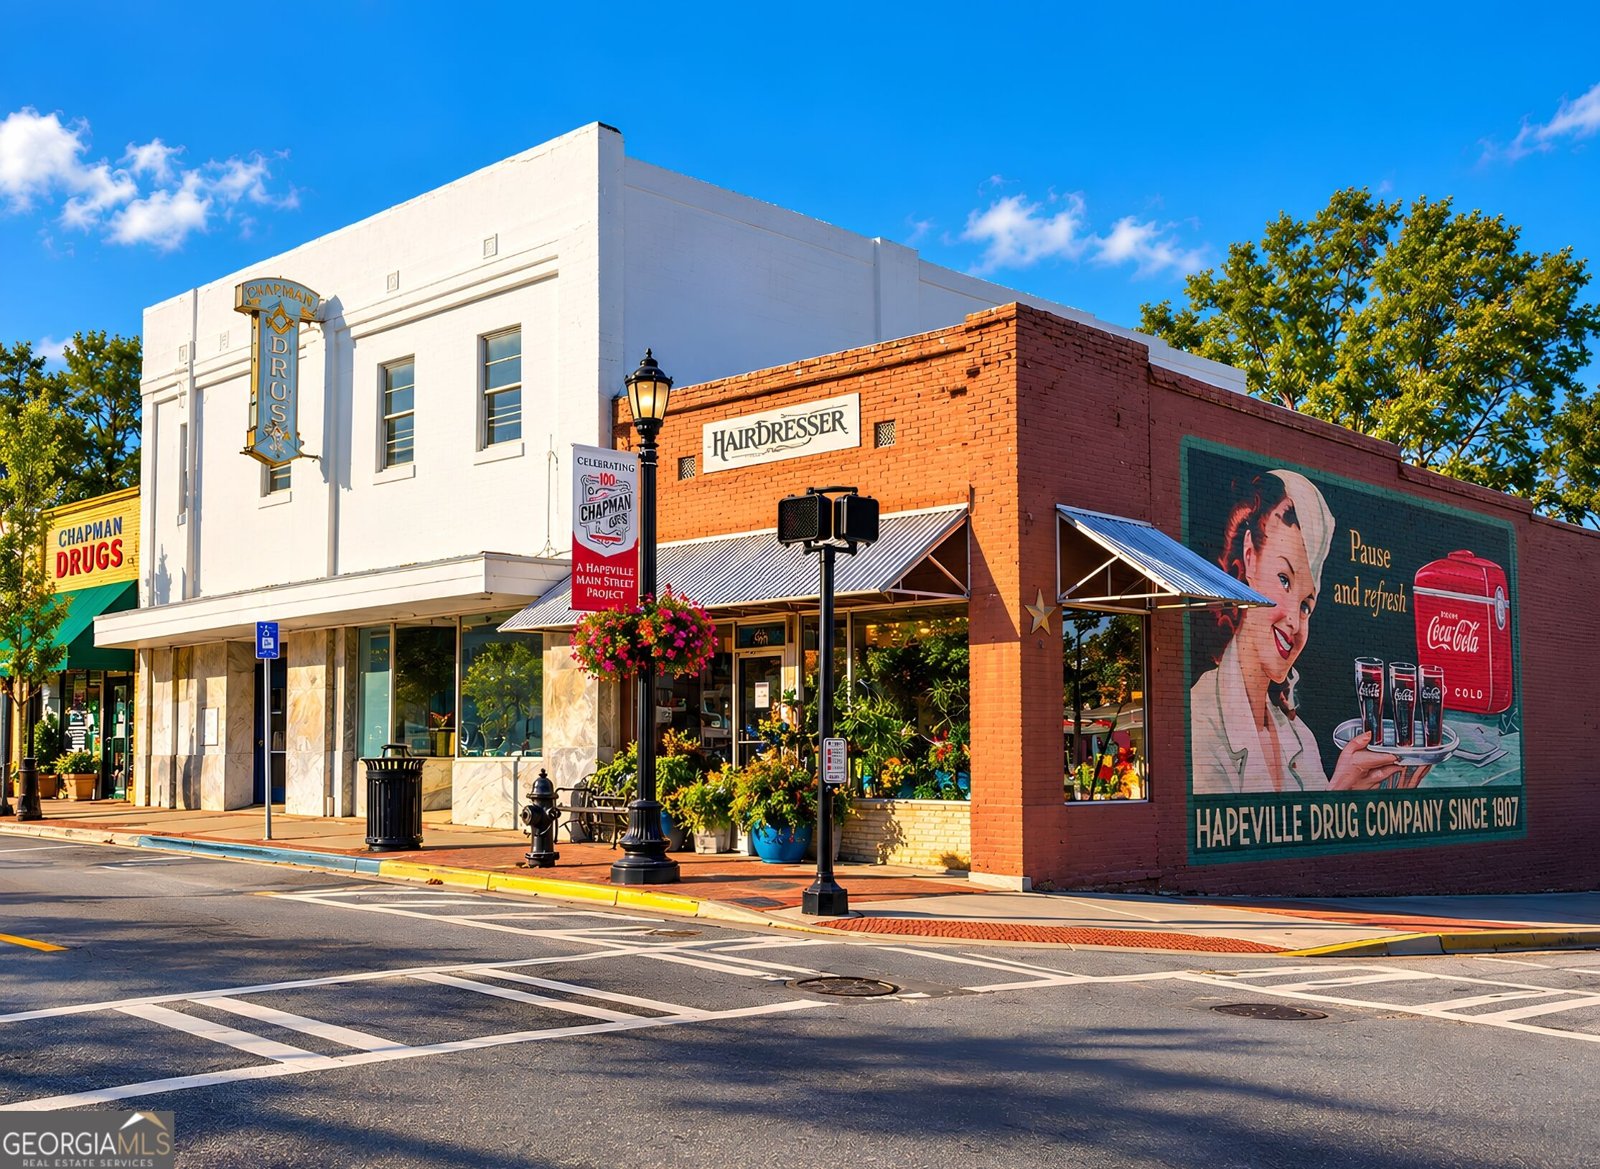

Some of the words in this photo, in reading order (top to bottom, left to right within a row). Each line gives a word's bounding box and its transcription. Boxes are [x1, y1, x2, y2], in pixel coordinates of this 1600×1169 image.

[711, 410, 849, 462] HAIRDRESSER
[577, 456, 635, 473] CELEBRATING
[599, 472, 616, 487] 100
[580, 494, 631, 522] CHAPMAN
[58, 516, 123, 548] CHAPMAN
[56, 538, 123, 579] DRUGS
[1350, 529, 1391, 568] Pause
[576, 562, 583, 572] A
[586, 563, 634, 576] HAPEVILLE
[576, 575, 601, 585] MAIN
[586, 587, 625, 600] PROJECT
[1334, 576, 1360, 606] and
[1364, 579, 1407, 617] refresh
[1454, 688, 1483, 699] COLD
[1196, 804, 1302, 849] HAPEVILLE
[1310, 802, 1358, 841] DRUG
[1365, 799, 1443, 837] COMPANY
[1449, 797, 1489, 831] SINCE
[1492, 796, 1519, 827] 1907
